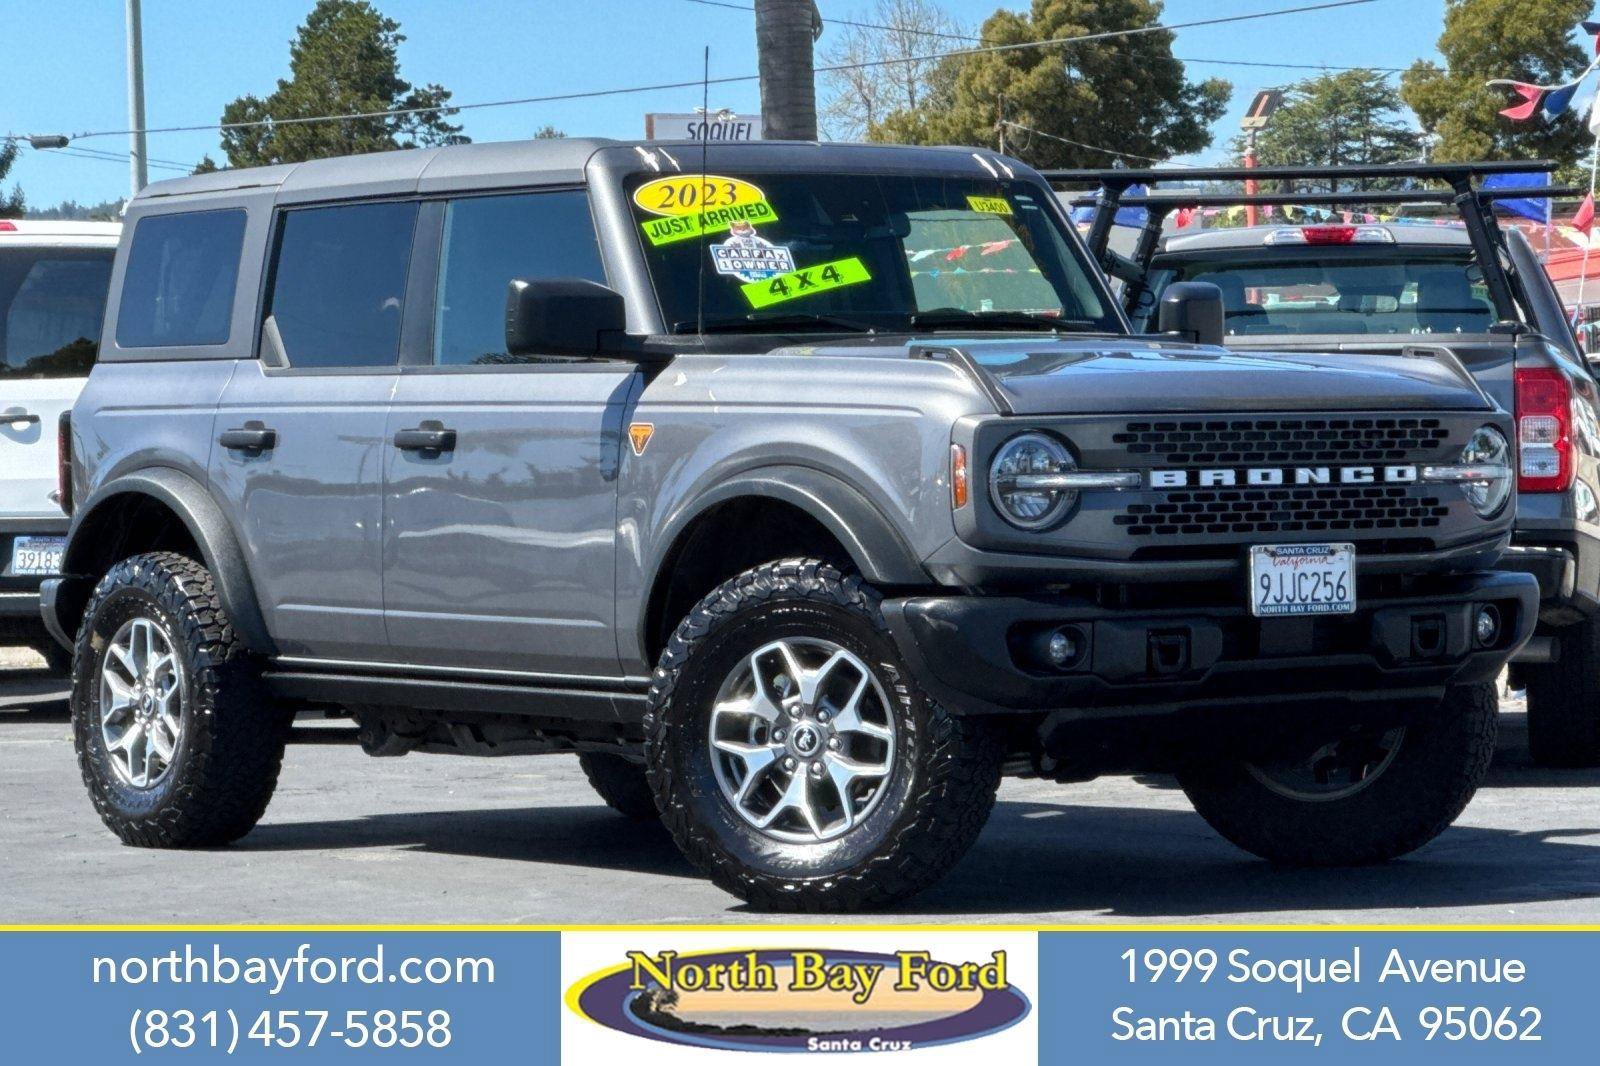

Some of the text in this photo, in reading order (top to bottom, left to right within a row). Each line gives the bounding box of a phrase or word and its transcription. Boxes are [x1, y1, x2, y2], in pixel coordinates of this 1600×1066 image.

[686, 121, 753, 141] SOQUEL
[657, 182, 738, 209] 2023
[650, 201, 769, 239] JUST ARRIVED
[716, 248, 788, 262] CARFAX
[1150, 465, 1418, 488] BRONCO
[1276, 546, 1331, 555] SANTA CRUZ
[1260, 570, 1347, 605] 9JJC256
[1260, 604, 1289, 614] NORTH
[1290, 604, 1306, 613] BAY
